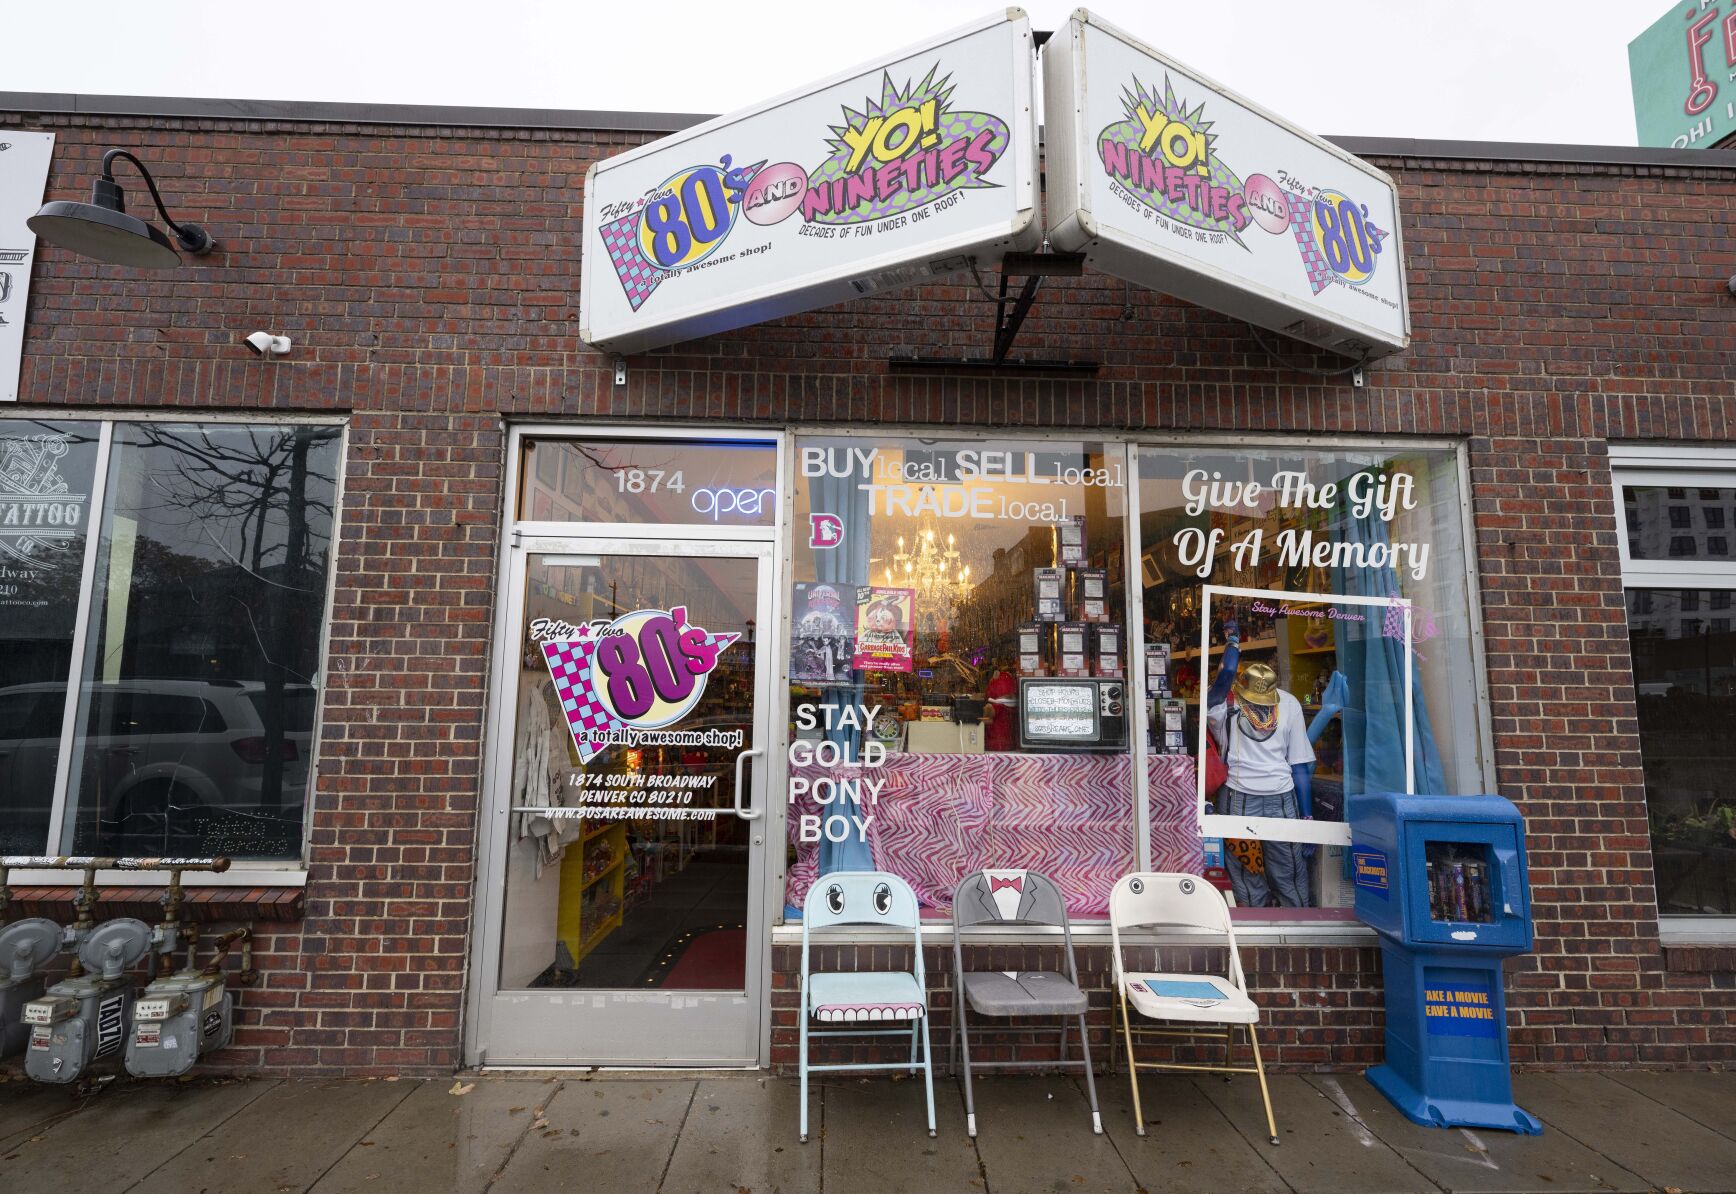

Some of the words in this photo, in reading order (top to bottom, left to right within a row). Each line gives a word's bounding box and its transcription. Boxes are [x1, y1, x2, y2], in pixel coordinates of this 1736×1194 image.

[842, 99, 943, 175] YO!
[1134, 103, 1210, 176] YO!
[746, 176, 803, 210] AND
[803, 129, 999, 223] NINETIES
[1101, 138, 1247, 230] NINETIES
[1278, 170, 1306, 196] Fifty
[1312, 187, 1334, 207] Two
[600, 196, 634, 220] Fifty
[643, 187, 673, 208] Two
[646, 153, 754, 267] 80's
[799, 223, 835, 238] DECADES
[840, 225, 851, 237] OF
[855, 222, 873, 237] FUN
[877, 216, 907, 234] UNDER
[912, 209, 932, 228] ONE
[935, 190, 966, 220] ROOF!
[1109, 181, 1142, 213] DECADES
[1143, 209, 1153, 219] OF
[1155, 215, 1169, 230] FUN
[1171, 222, 1193, 240] UNDER
[1195, 231, 1208, 243] ONE
[1209, 233, 1229, 245] ROOF!
[1248, 190, 1287, 219] AND
[1314, 199, 1383, 274] 80's
[649, 267, 684, 286] totally
[686, 253, 736, 274] awesome
[739, 241, 773, 262] shop!
[1349, 282, 1379, 303] awesome
[1381, 297, 1399, 311] shop!
[613, 469, 686, 494] 1874
[801, 447, 878, 478] BUY
[877, 455, 948, 482] local
[955, 450, 1052, 484] SELL
[1053, 461, 1124, 488] local
[857, 484, 995, 518] TRADE
[996, 495, 1070, 522] local
[1182, 469, 1261, 517] Give
[1271, 470, 1337, 509] The
[1348, 471, 1418, 522] Gift
[1172, 527, 1224, 578] Of
[1230, 528, 1264, 572] A
[1276, 529, 1430, 581] Memory
[1251, 601, 1277, 617] Stay
[1278, 603, 1325, 619] Awesome
[1328, 607, 1366, 621] Denver
[531, 619, 576, 640] Fifty
[591, 620, 625, 638] Two
[597, 607, 717, 720] 80's
[796, 703, 882, 731] STAY
[580, 731, 588, 742] a
[592, 729, 637, 746] totally
[640, 732, 702, 745] awesome
[705, 729, 742, 747] shop!
[788, 740, 887, 768] GOLD
[568, 773, 603, 788] 1874
[604, 774, 644, 788] SOUTH
[647, 774, 716, 789] BROADWAY
[579, 790, 626, 803] DENVER
[629, 790, 646, 803] CO
[648, 791, 692, 804] 80210
[789, 777, 886, 805] PONY
[800, 815, 875, 843] BOY
[1446, 991, 1454, 1002] A
[1455, 992, 1489, 1004] MOVIE
[1451, 1006, 1458, 1018] A
[1459, 1007, 1494, 1020] MOVIE
